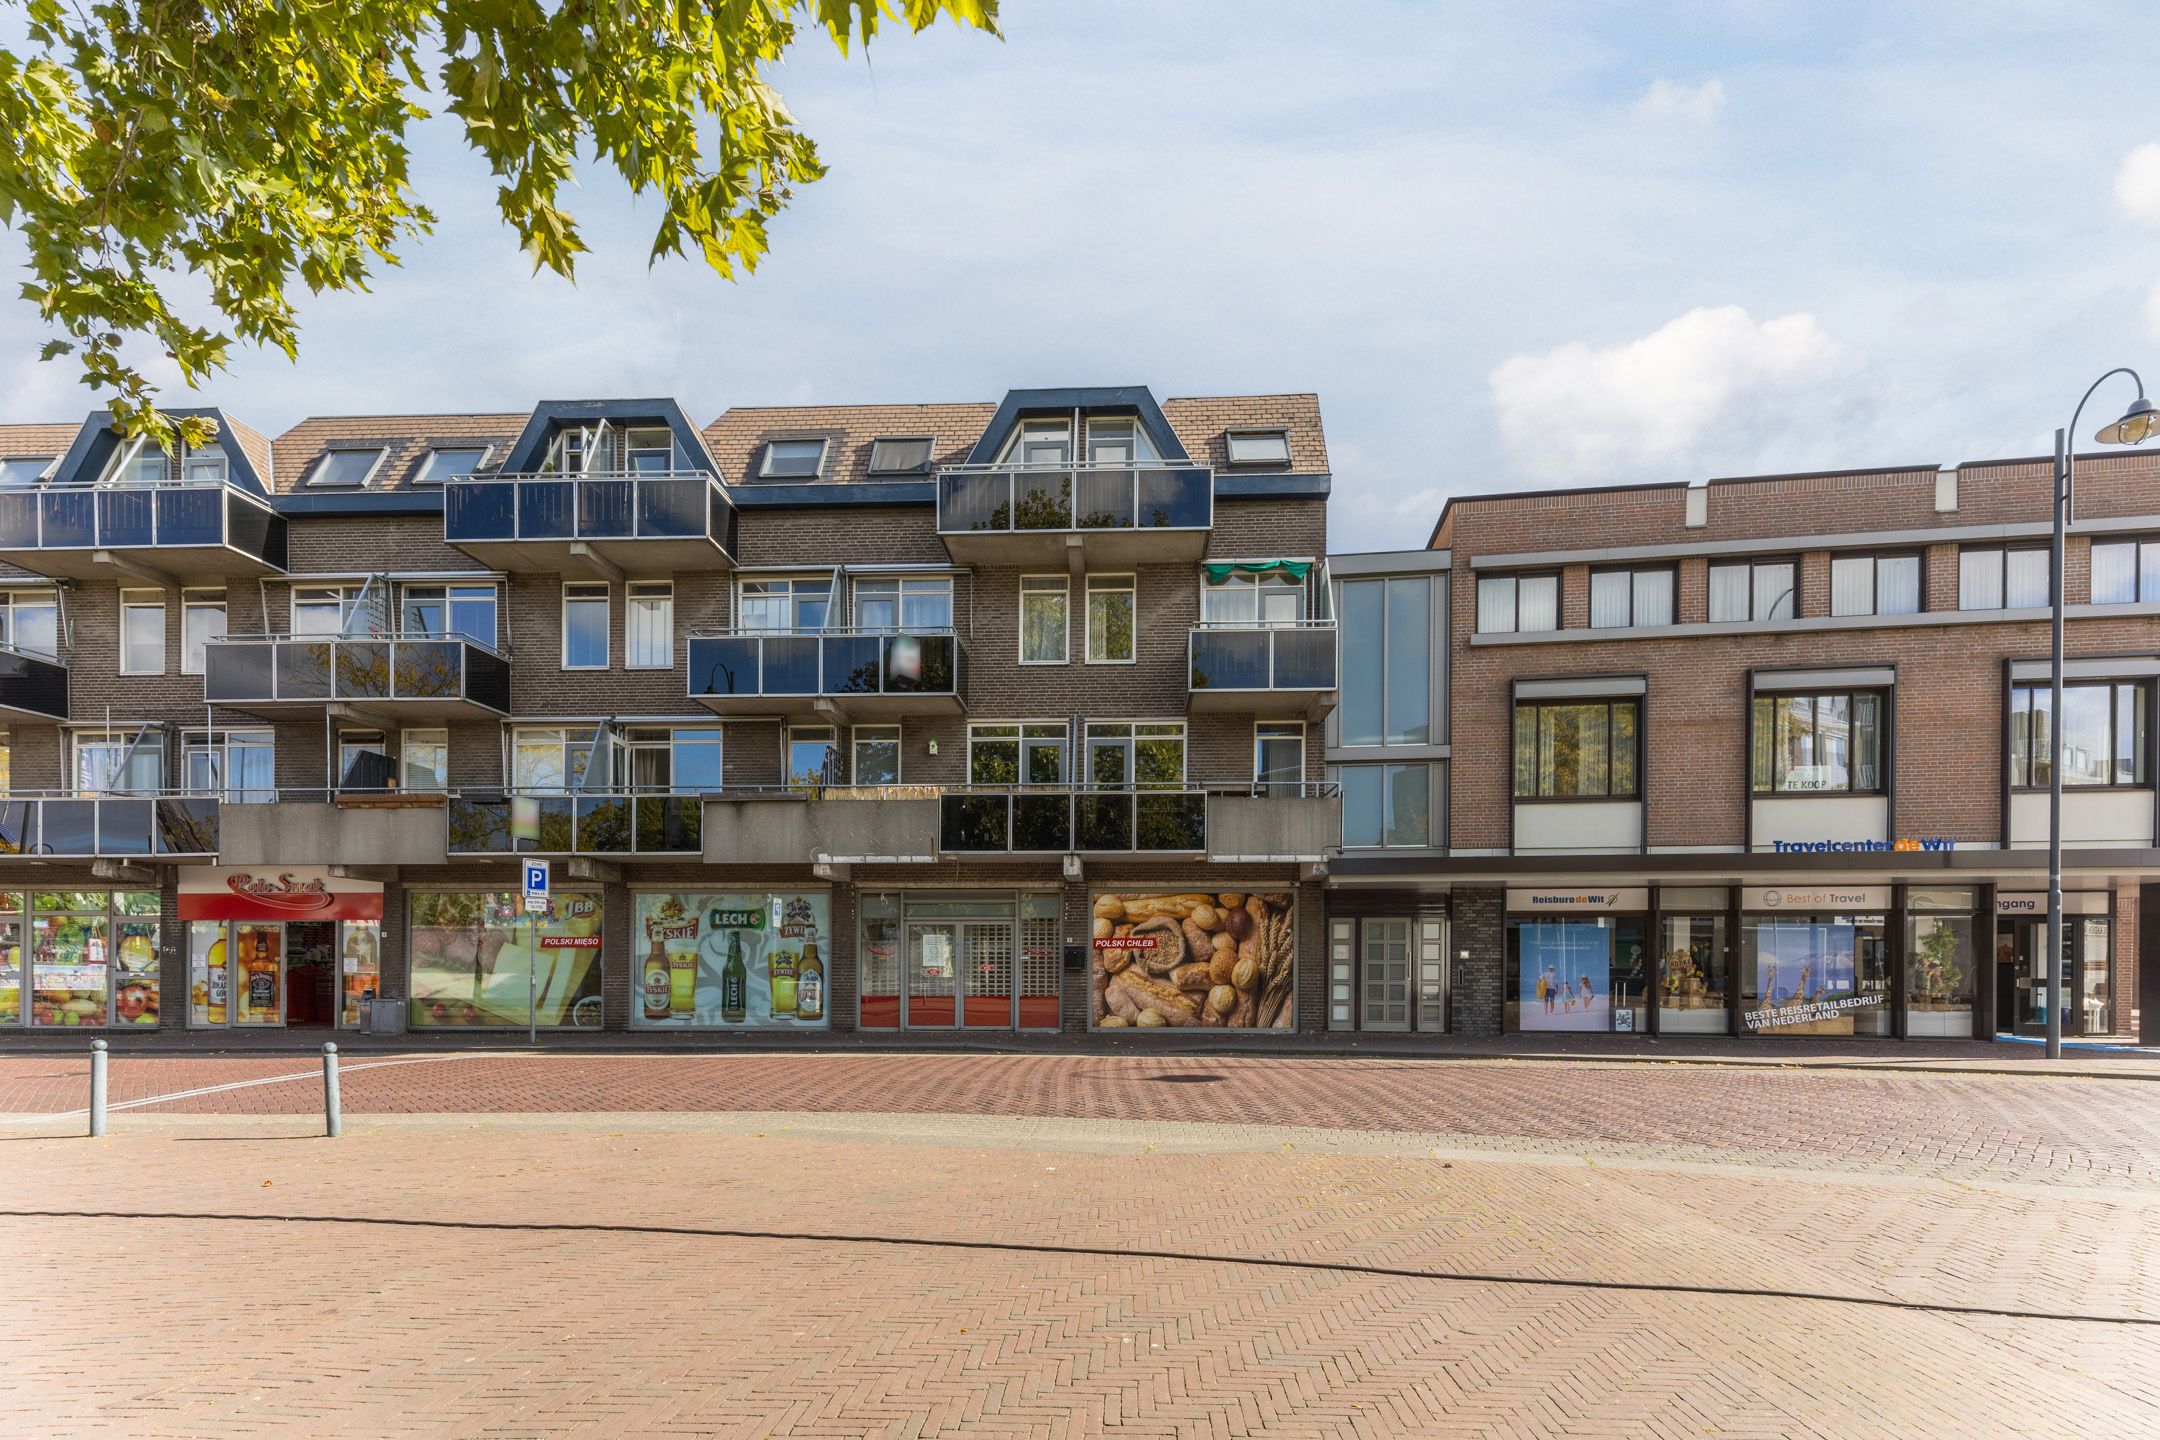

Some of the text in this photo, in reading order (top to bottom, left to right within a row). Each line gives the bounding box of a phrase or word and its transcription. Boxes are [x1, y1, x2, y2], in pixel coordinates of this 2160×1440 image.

[1788, 780, 1826, 789] TE KOOP
[532, 870, 542, 888] P
[1787, 893, 1866, 904] Best of Travel
[564, 900, 594, 920] JBB
[716, 913, 748, 924] LECH
[574, 938, 598, 946] MIĘSO
[646, 985, 668, 994] TYSKIE
[1745, 995, 1884, 1021] BESTE REISRETAILBEDRIJF
[1746, 1010, 1840, 1030] VAN NEDERLAND
